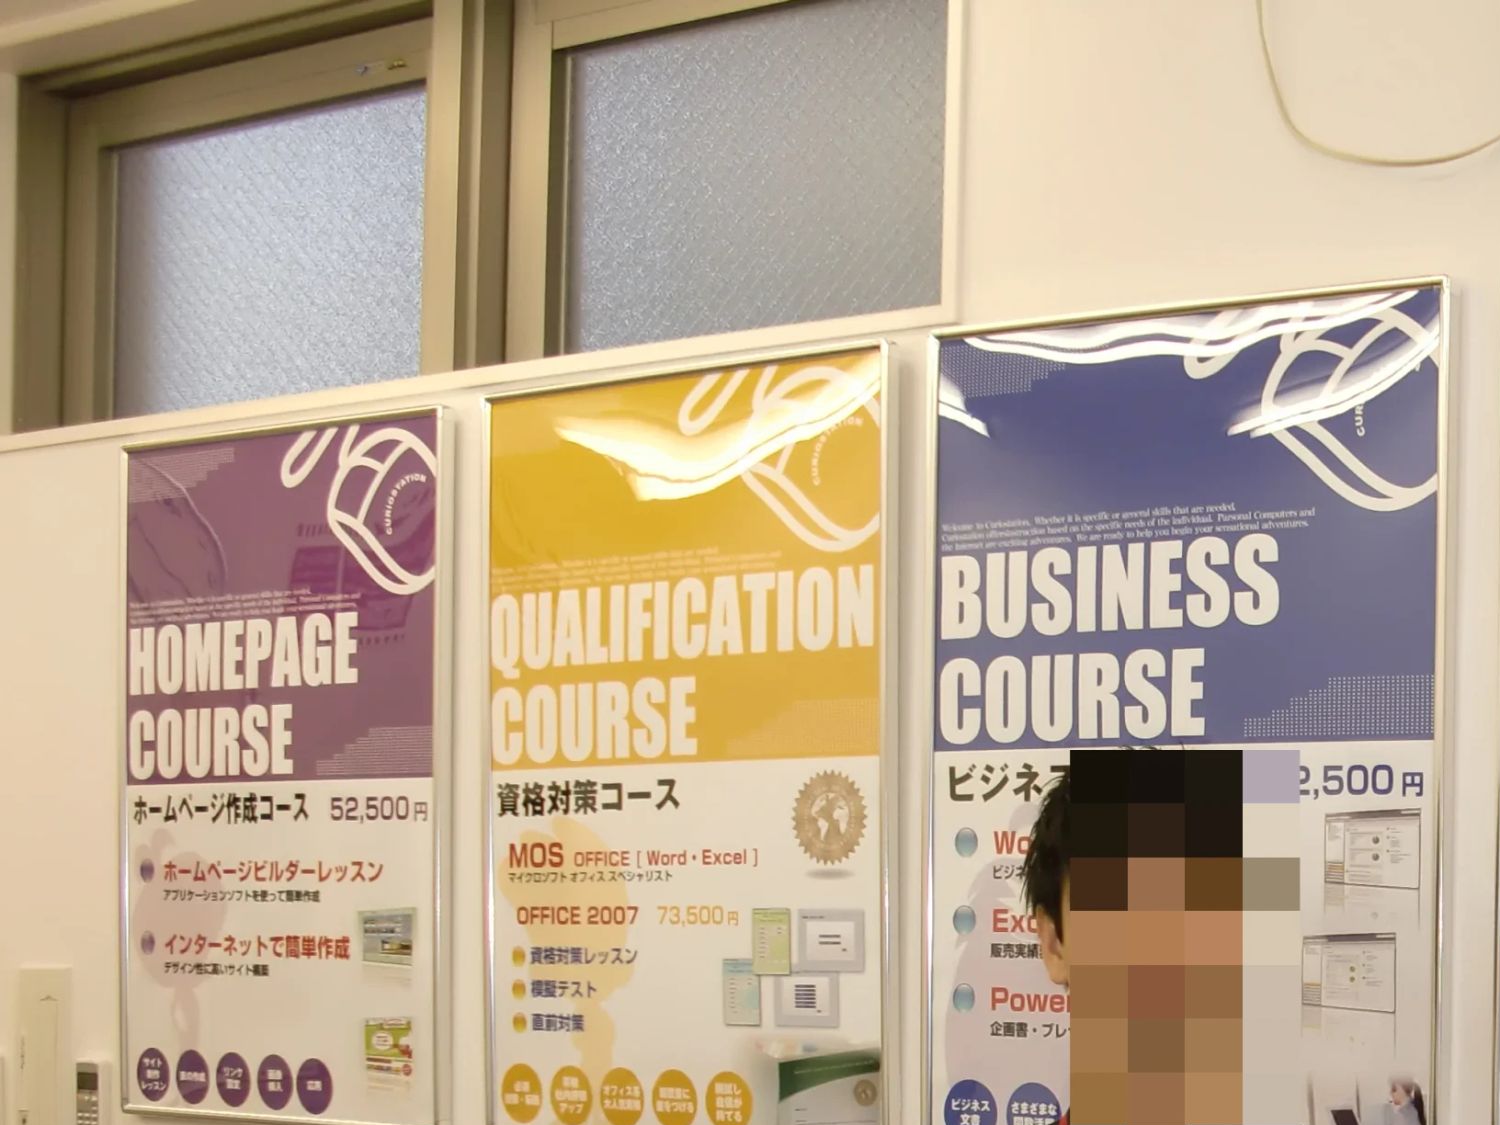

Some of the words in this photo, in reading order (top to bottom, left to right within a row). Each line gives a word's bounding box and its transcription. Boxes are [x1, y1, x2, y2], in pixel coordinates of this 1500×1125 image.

[940, 533, 1279, 640] BUSINESS
[491, 564, 874, 680] QUALIFICATION
[129, 611, 359, 696] HOMEPAGE
[939, 647, 1206, 745] COURSE
[491, 676, 698, 765] COURSE
[129, 703, 294, 780] COURSE
[133, 793, 309, 825] ホームページ作成コース
[497, 777, 681, 818] 資格対策コース
[509, 842, 564, 868] MOS
[574, 851, 630, 867] OFFICE
[164, 860, 384, 883] ホームページビルダーレッスン
[516, 906, 580, 925] OFFICE
[587, 906, 638, 925] 2007
[164, 934, 351, 960] インターネットで簡単作成
[530, 945, 637, 966] 資格対策レッスン
[530, 978, 597, 999] 模擬テスト
[950, 1098, 991, 1113] ビジネス
